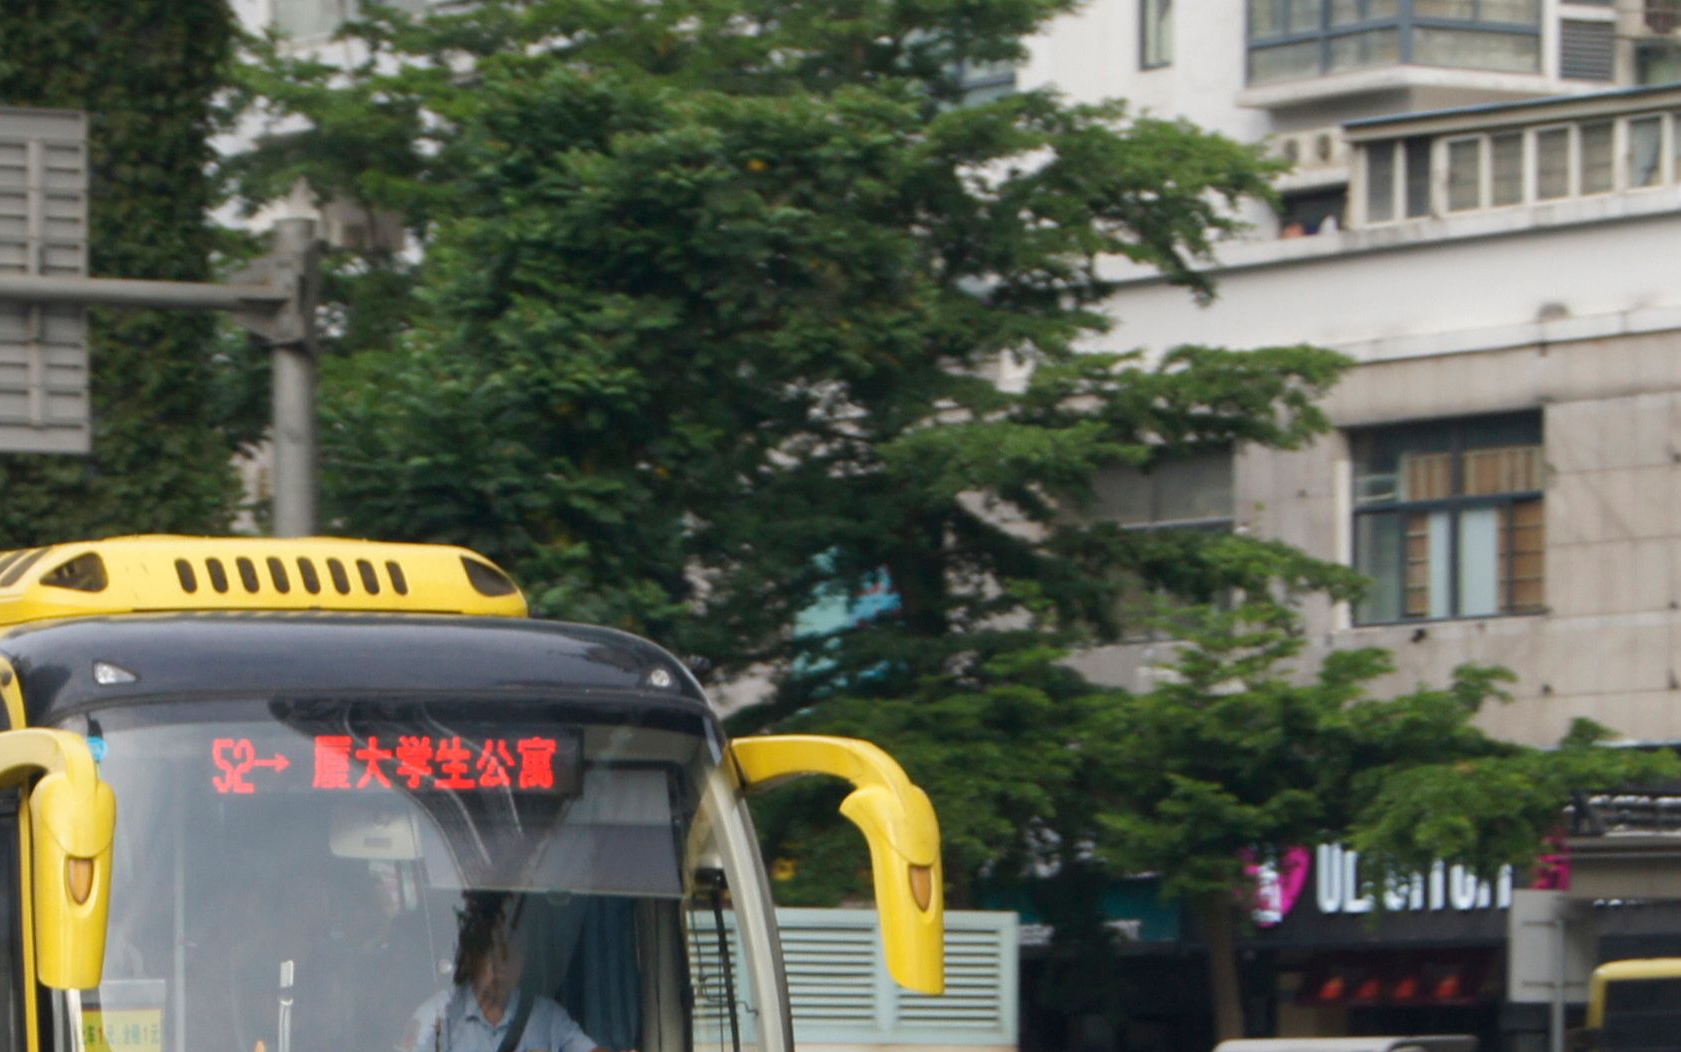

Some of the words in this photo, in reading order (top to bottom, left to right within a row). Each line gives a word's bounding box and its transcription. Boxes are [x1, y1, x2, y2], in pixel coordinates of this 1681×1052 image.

[212, 738, 255, 793] 52
[313, 734, 557, 790] 厦大学生公寓
